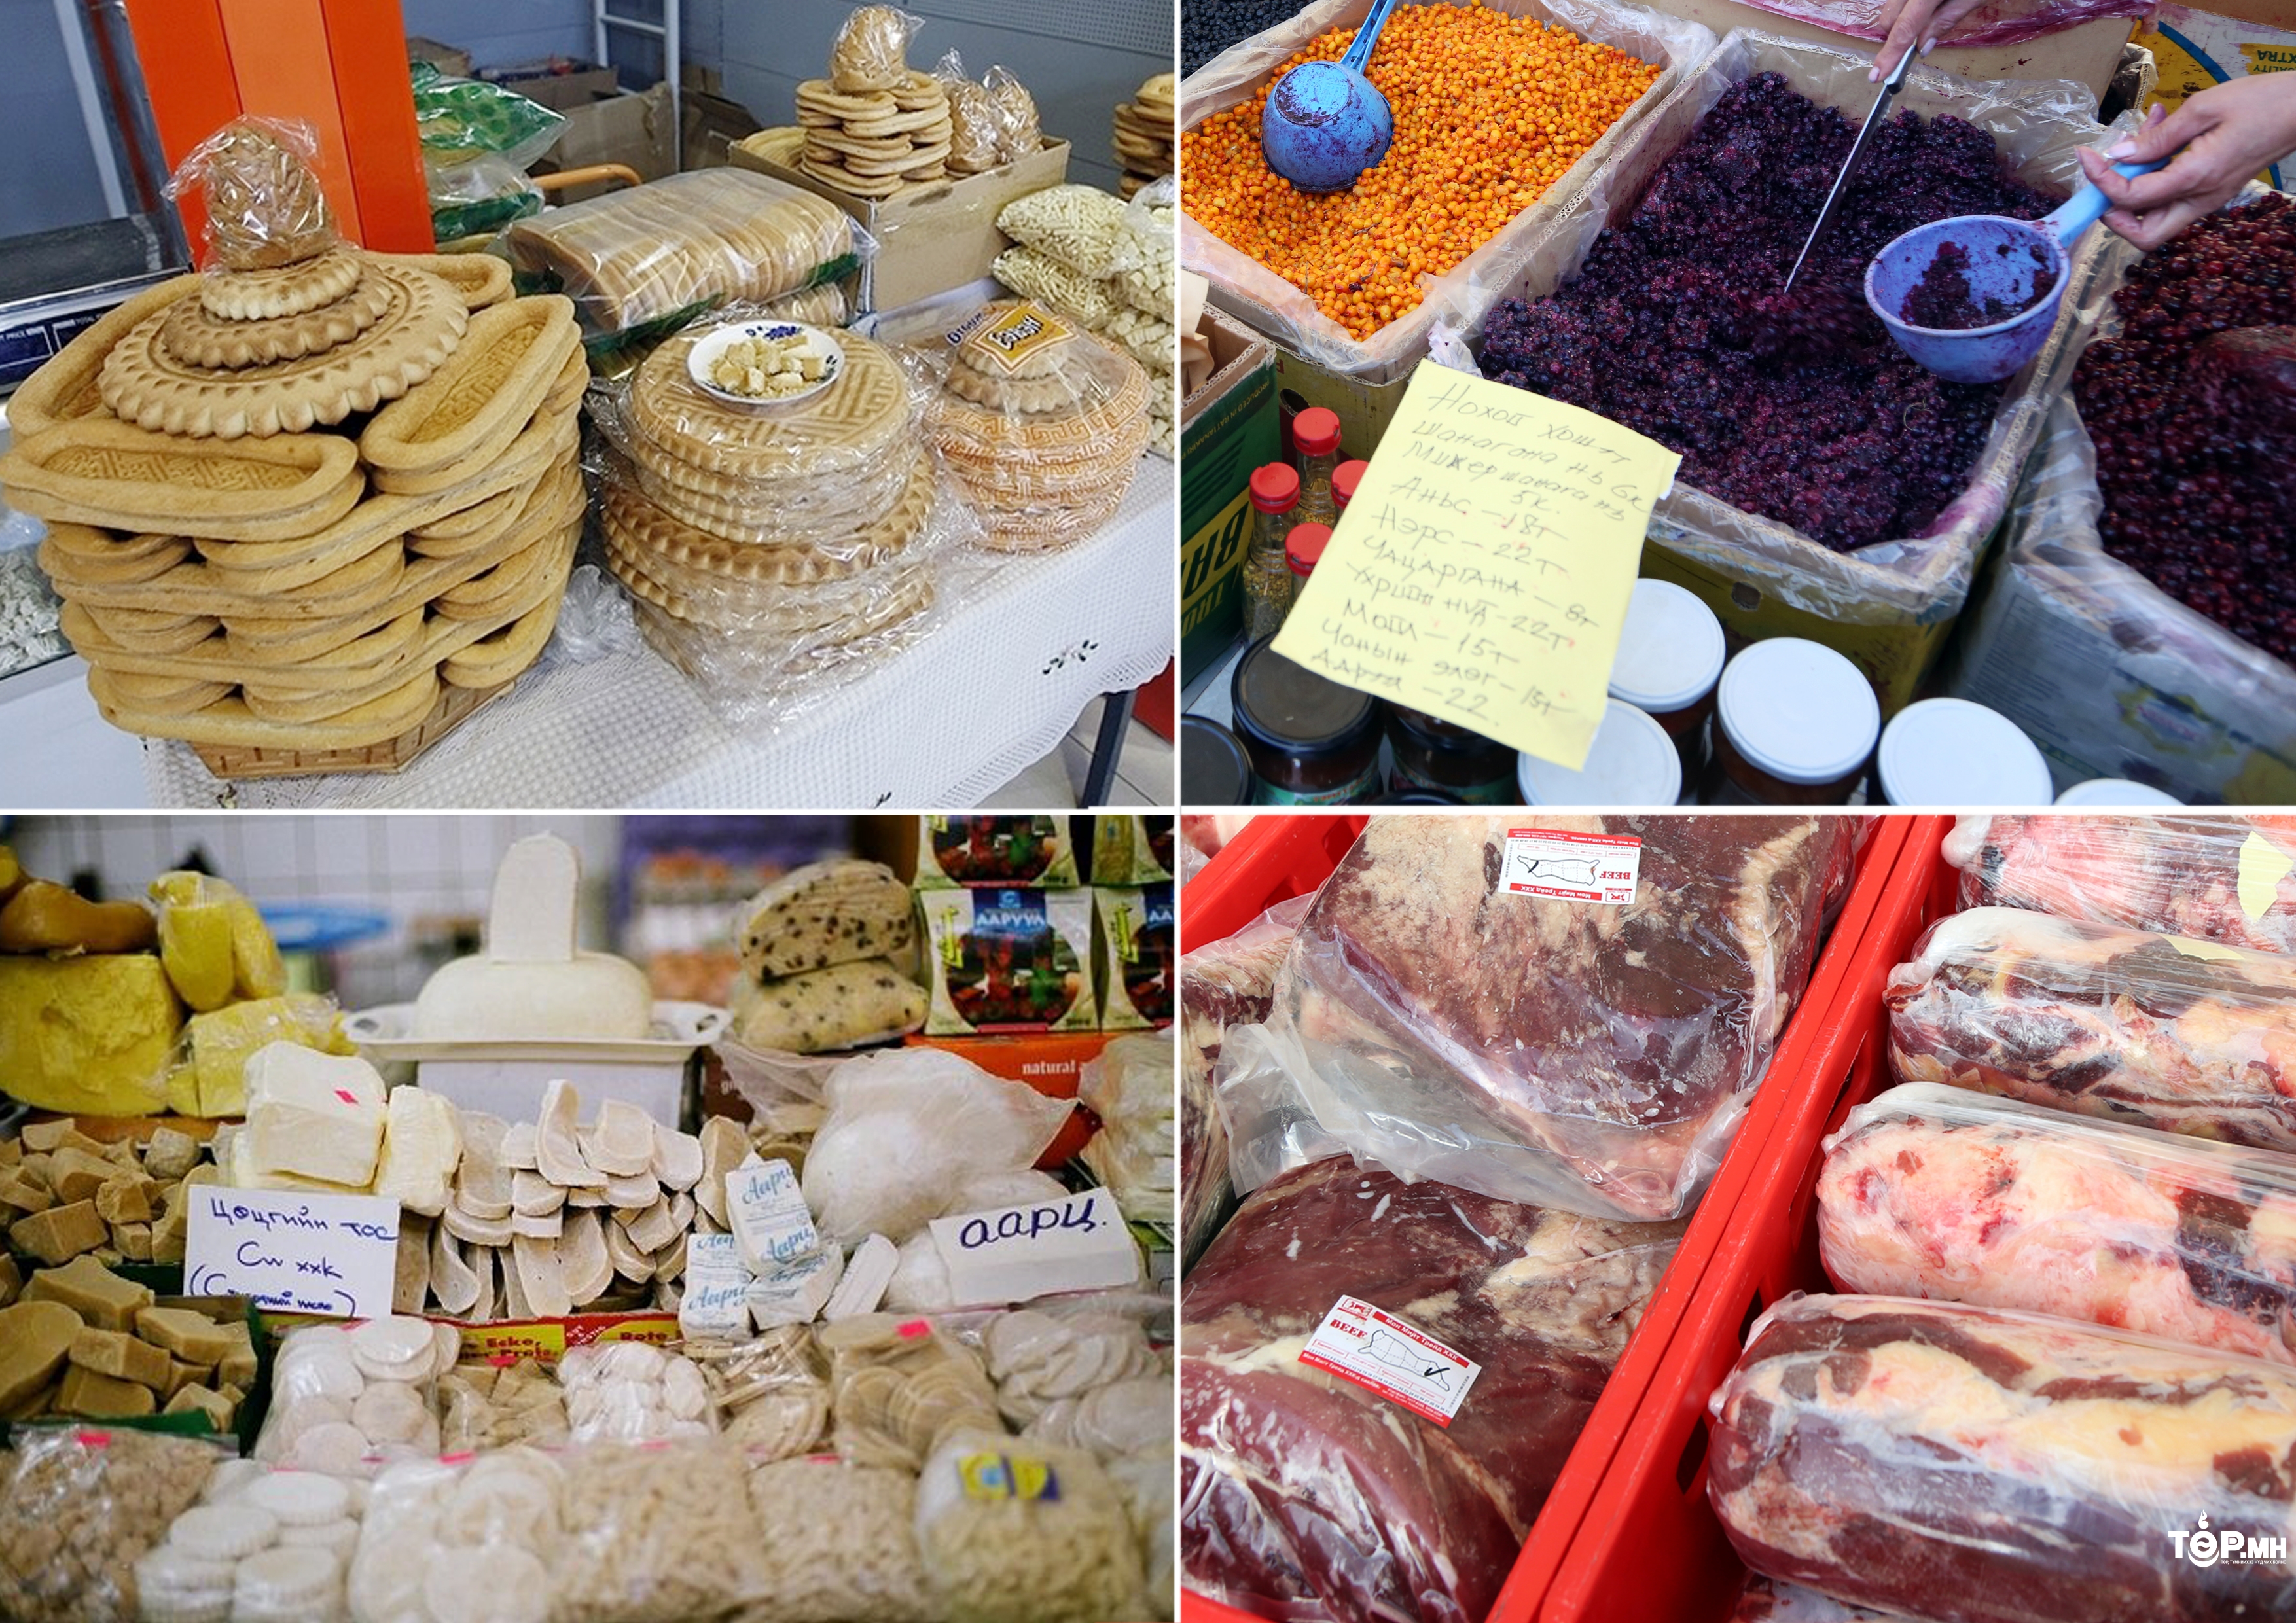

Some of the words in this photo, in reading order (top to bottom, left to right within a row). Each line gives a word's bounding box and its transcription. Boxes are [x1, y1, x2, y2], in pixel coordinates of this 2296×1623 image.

[1238, 378, 1270, 412] PRODUCED
[1230, 408, 1238, 419] IN
[1599, 870, 1631, 880] BEEF
[1535, 887, 1557, 896] Трейд
[1022, 1058, 1076, 1075] natural
[1329, 1318, 1368, 1339] BEEF
[1384, 1317, 1401, 1330] Мон
[1420, 1336, 1443, 1353] Трейд
[1443, 1349, 1460, 1361] ХХК
